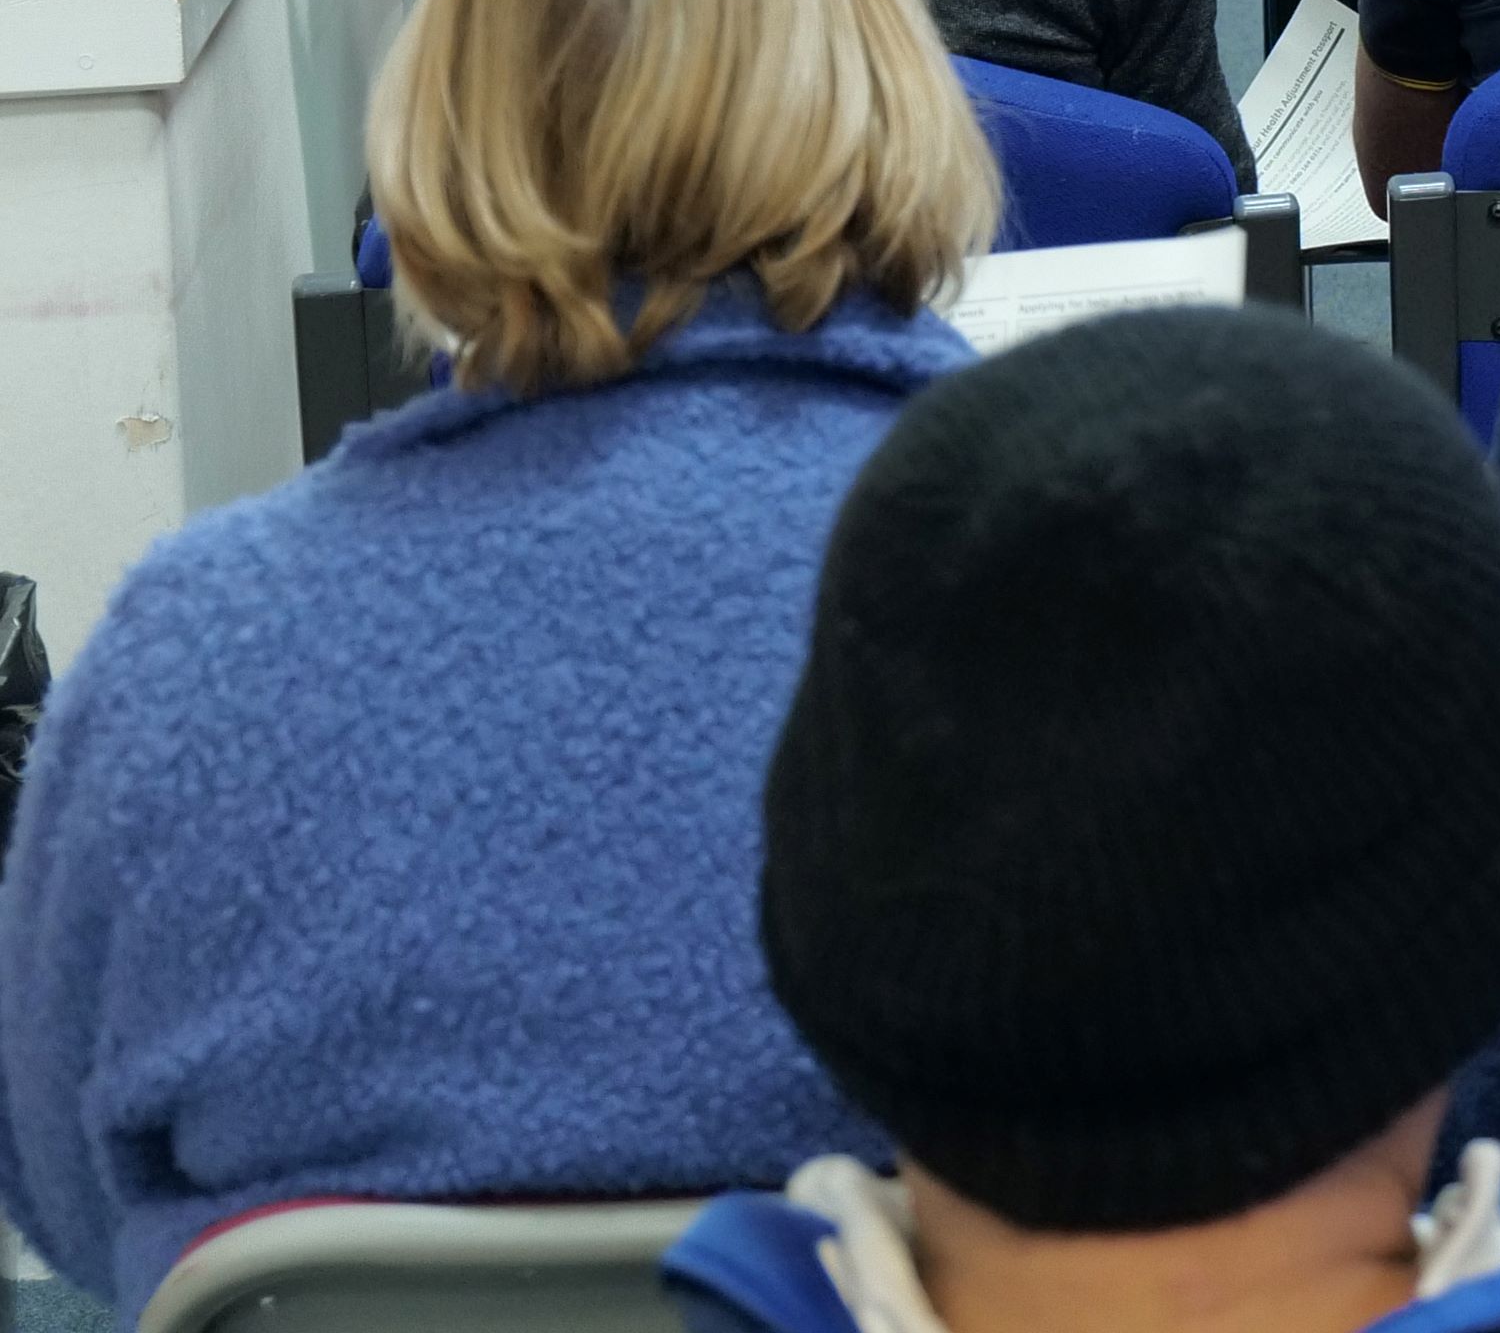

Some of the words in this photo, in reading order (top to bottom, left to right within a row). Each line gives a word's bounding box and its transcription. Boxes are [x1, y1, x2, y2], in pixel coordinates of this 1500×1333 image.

[1260, 108, 1285, 139] Health
[1282, 56, 1317, 108] Adjustment
[1311, 21, 1338, 57] Passport
[1263, 158, 1274, 172] can
[1273, 116, 1305, 159] communicate
[1303, 100, 1316, 116] with
[1313, 90, 1324, 104] you
[1018, 299, 1064, 315] Applying
